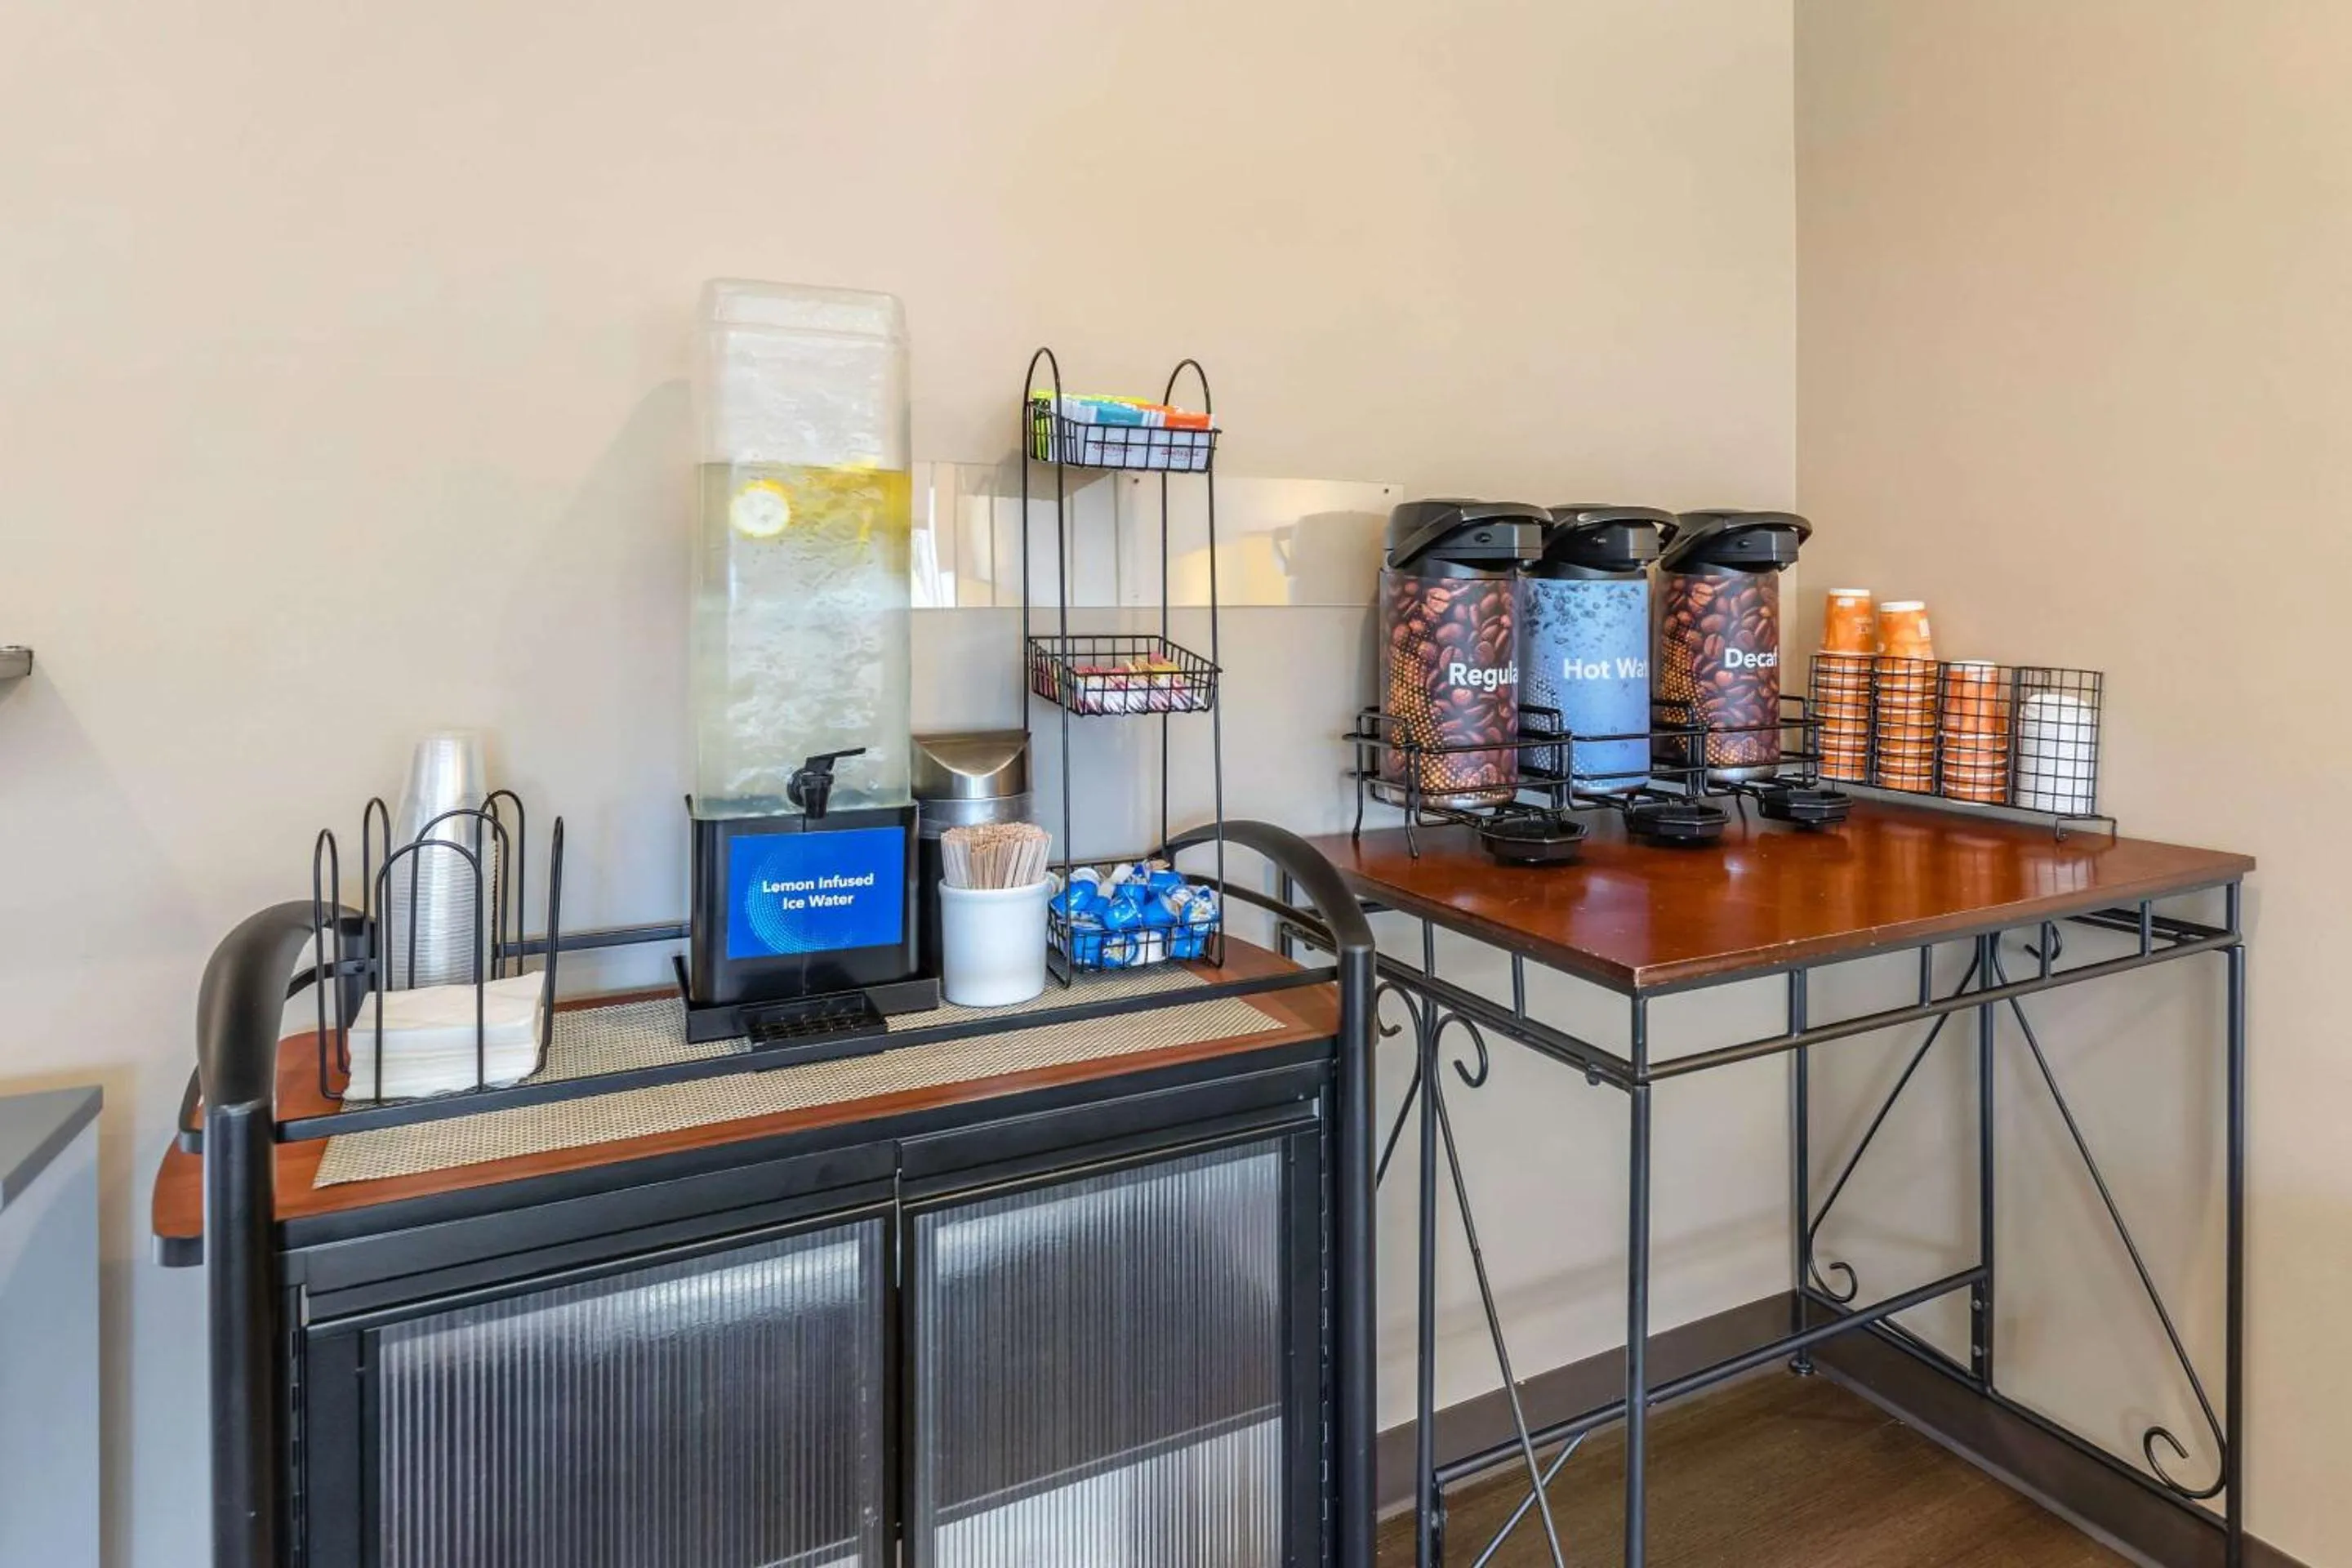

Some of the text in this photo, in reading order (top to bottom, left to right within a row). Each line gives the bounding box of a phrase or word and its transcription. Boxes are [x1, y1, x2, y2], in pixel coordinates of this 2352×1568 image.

[1563, 657, 1610, 679] Hot
[763, 872, 874, 893] Lemon Infused
[783, 894, 854, 911] Ice Water
